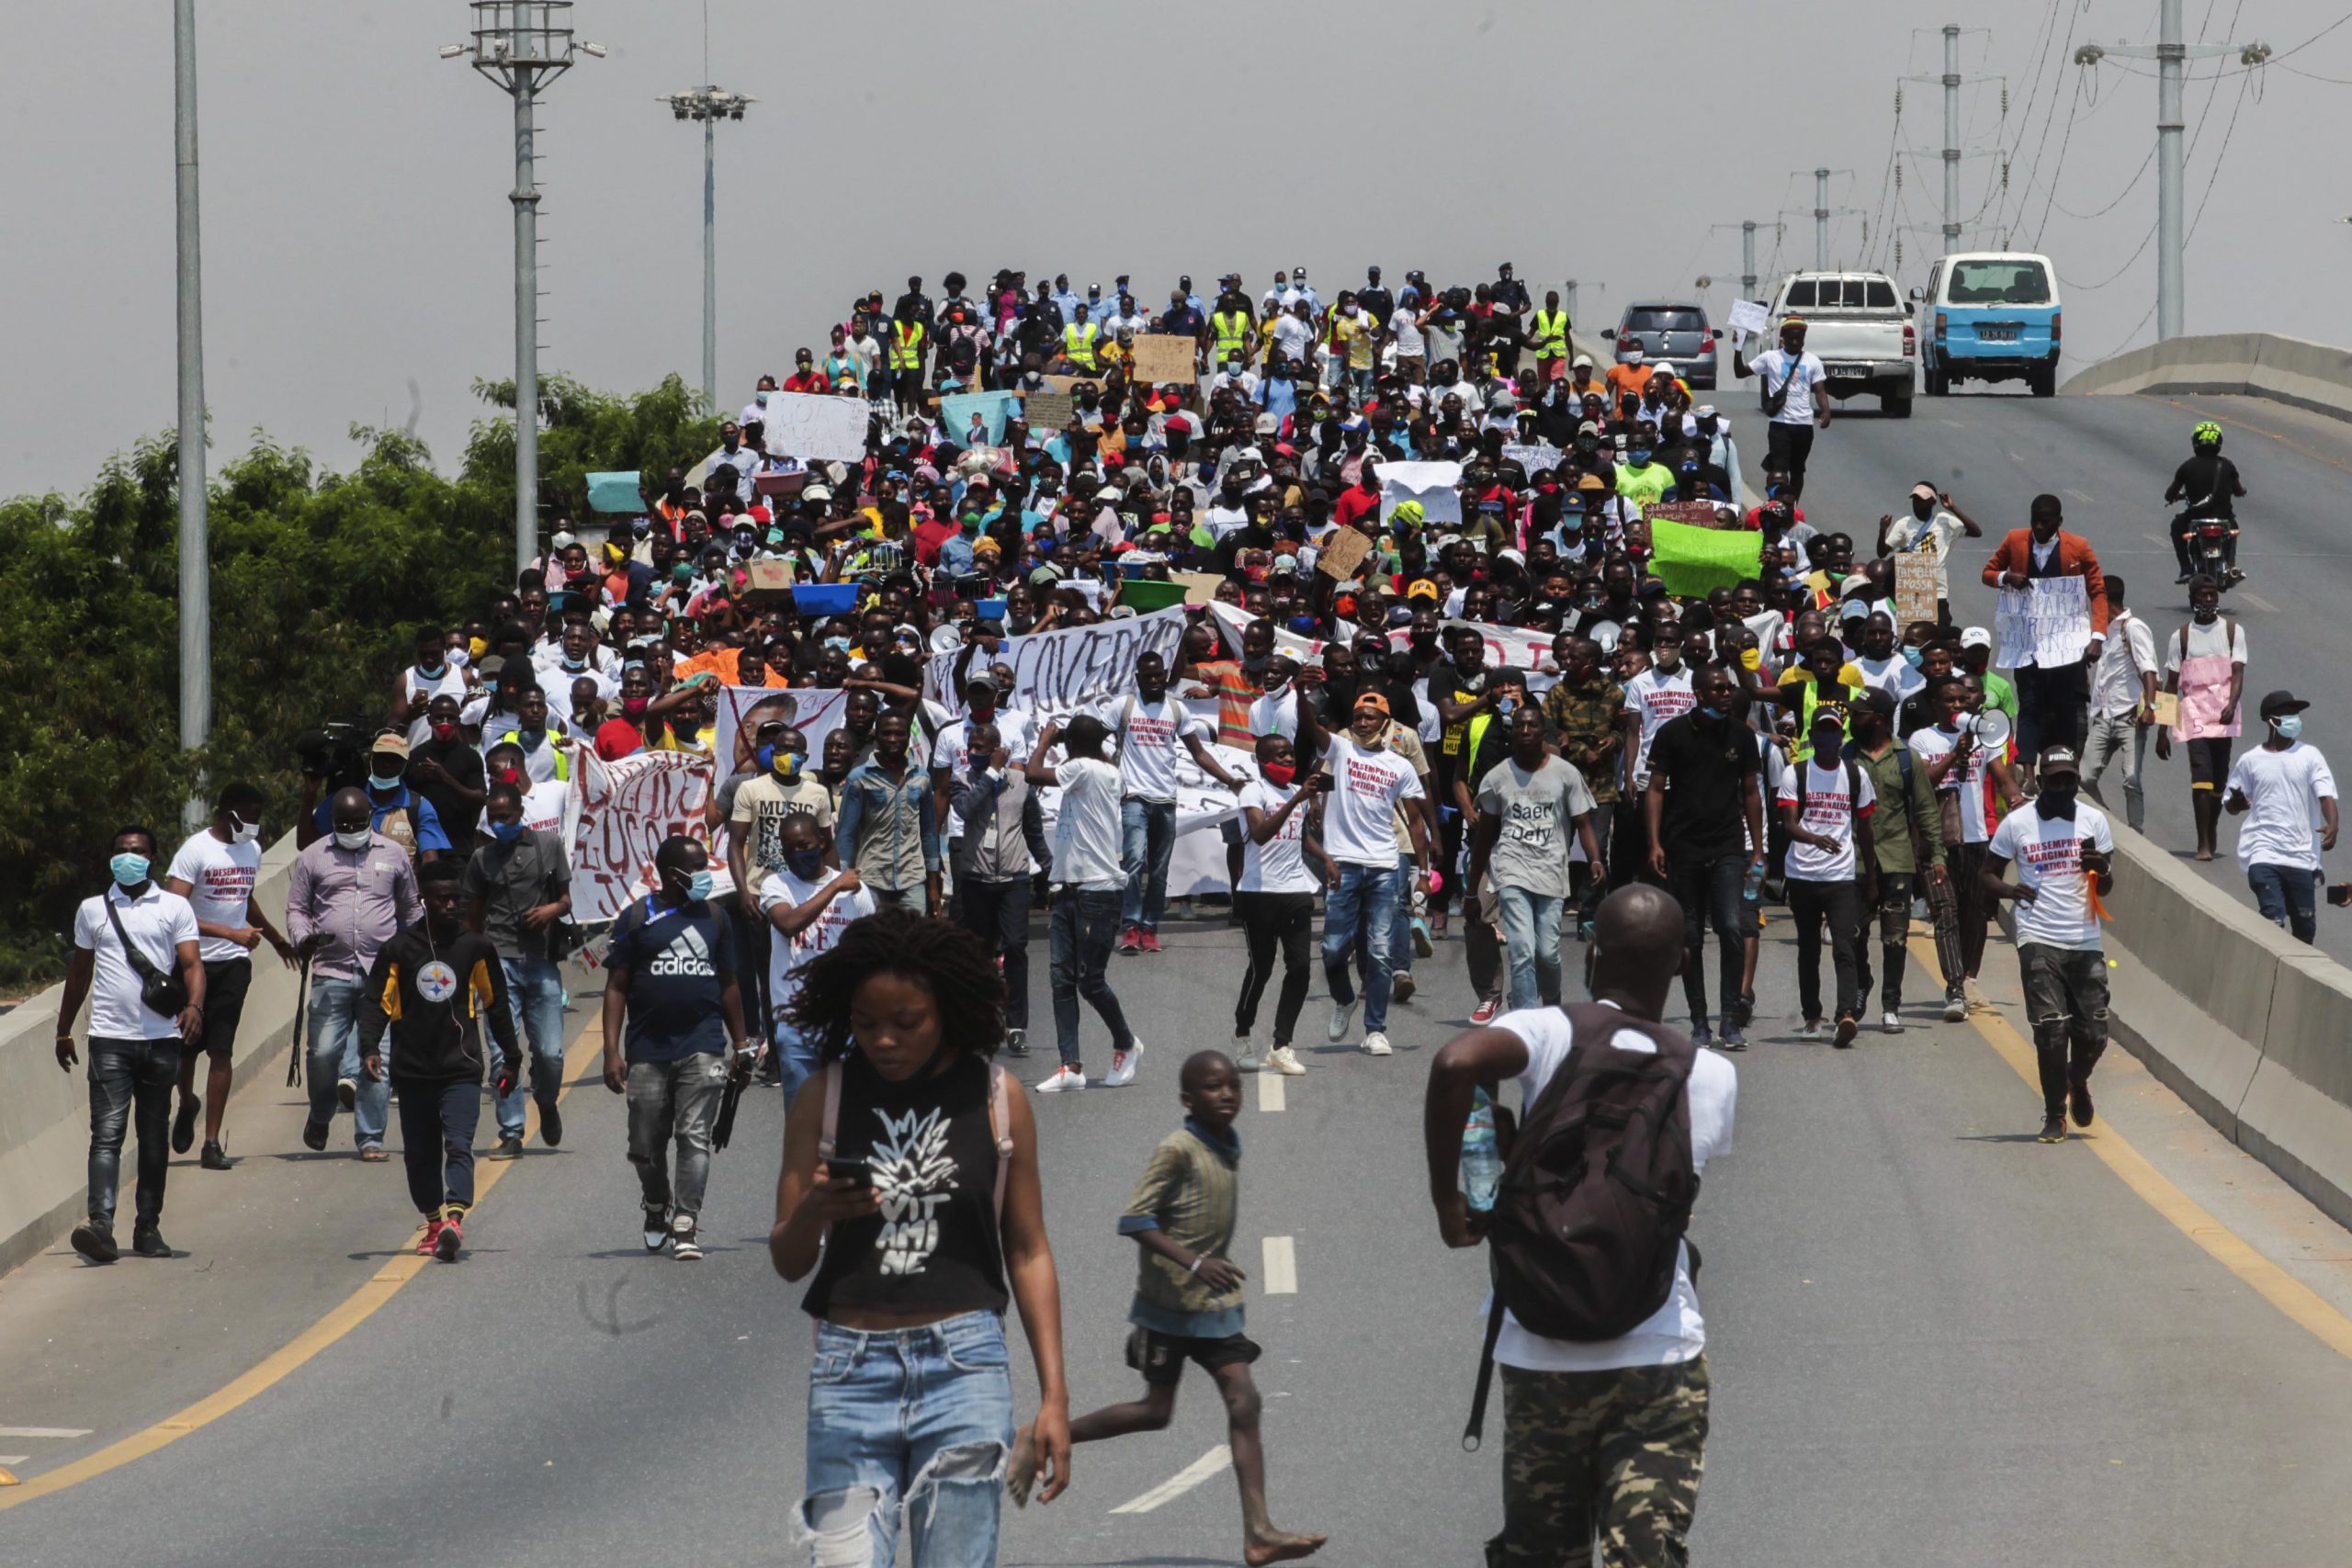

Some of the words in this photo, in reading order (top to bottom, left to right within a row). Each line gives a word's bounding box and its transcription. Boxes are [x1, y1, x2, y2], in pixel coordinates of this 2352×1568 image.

[1647, 698, 1692, 707] MARGINALIZA
[650, 955, 716, 976] adidas
[879, 1192, 952, 1223] VIT
